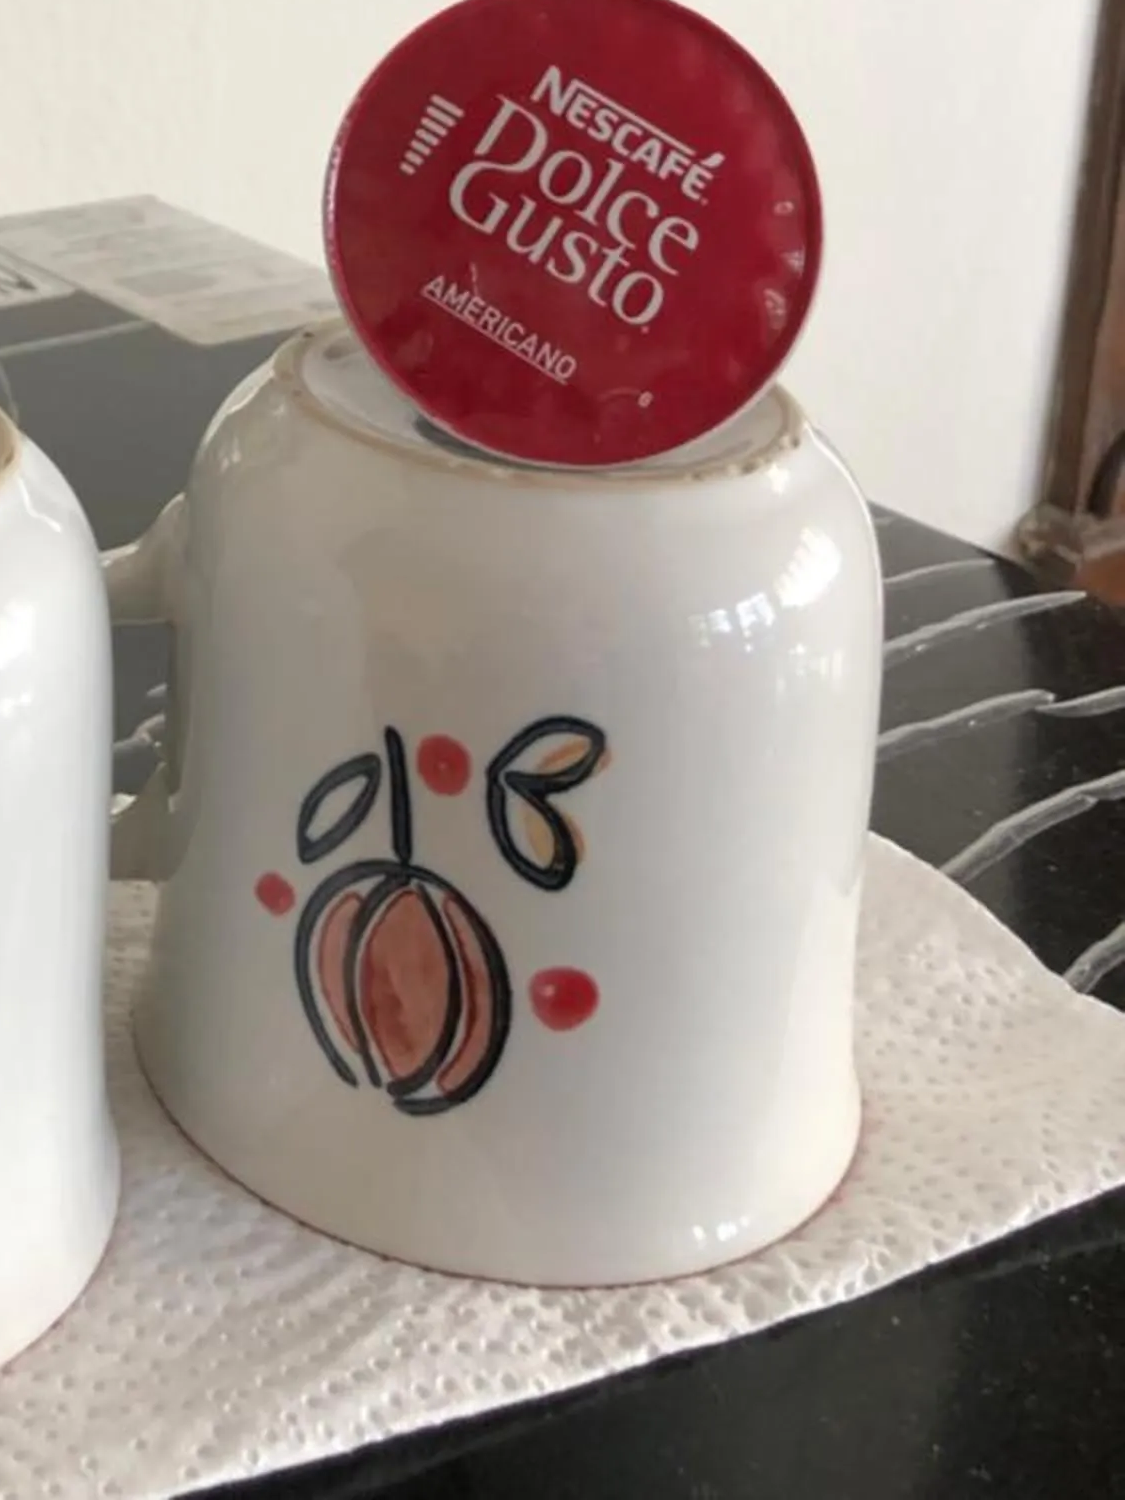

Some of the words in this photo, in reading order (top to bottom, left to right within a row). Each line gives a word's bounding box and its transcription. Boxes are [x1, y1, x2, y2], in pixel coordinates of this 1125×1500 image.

[474, 94, 700, 276] Dolce
[531, 65, 725, 201] NESCAFÉ
[449, 160, 665, 328] Gusto
[422, 274, 578, 383] AMERICANO
